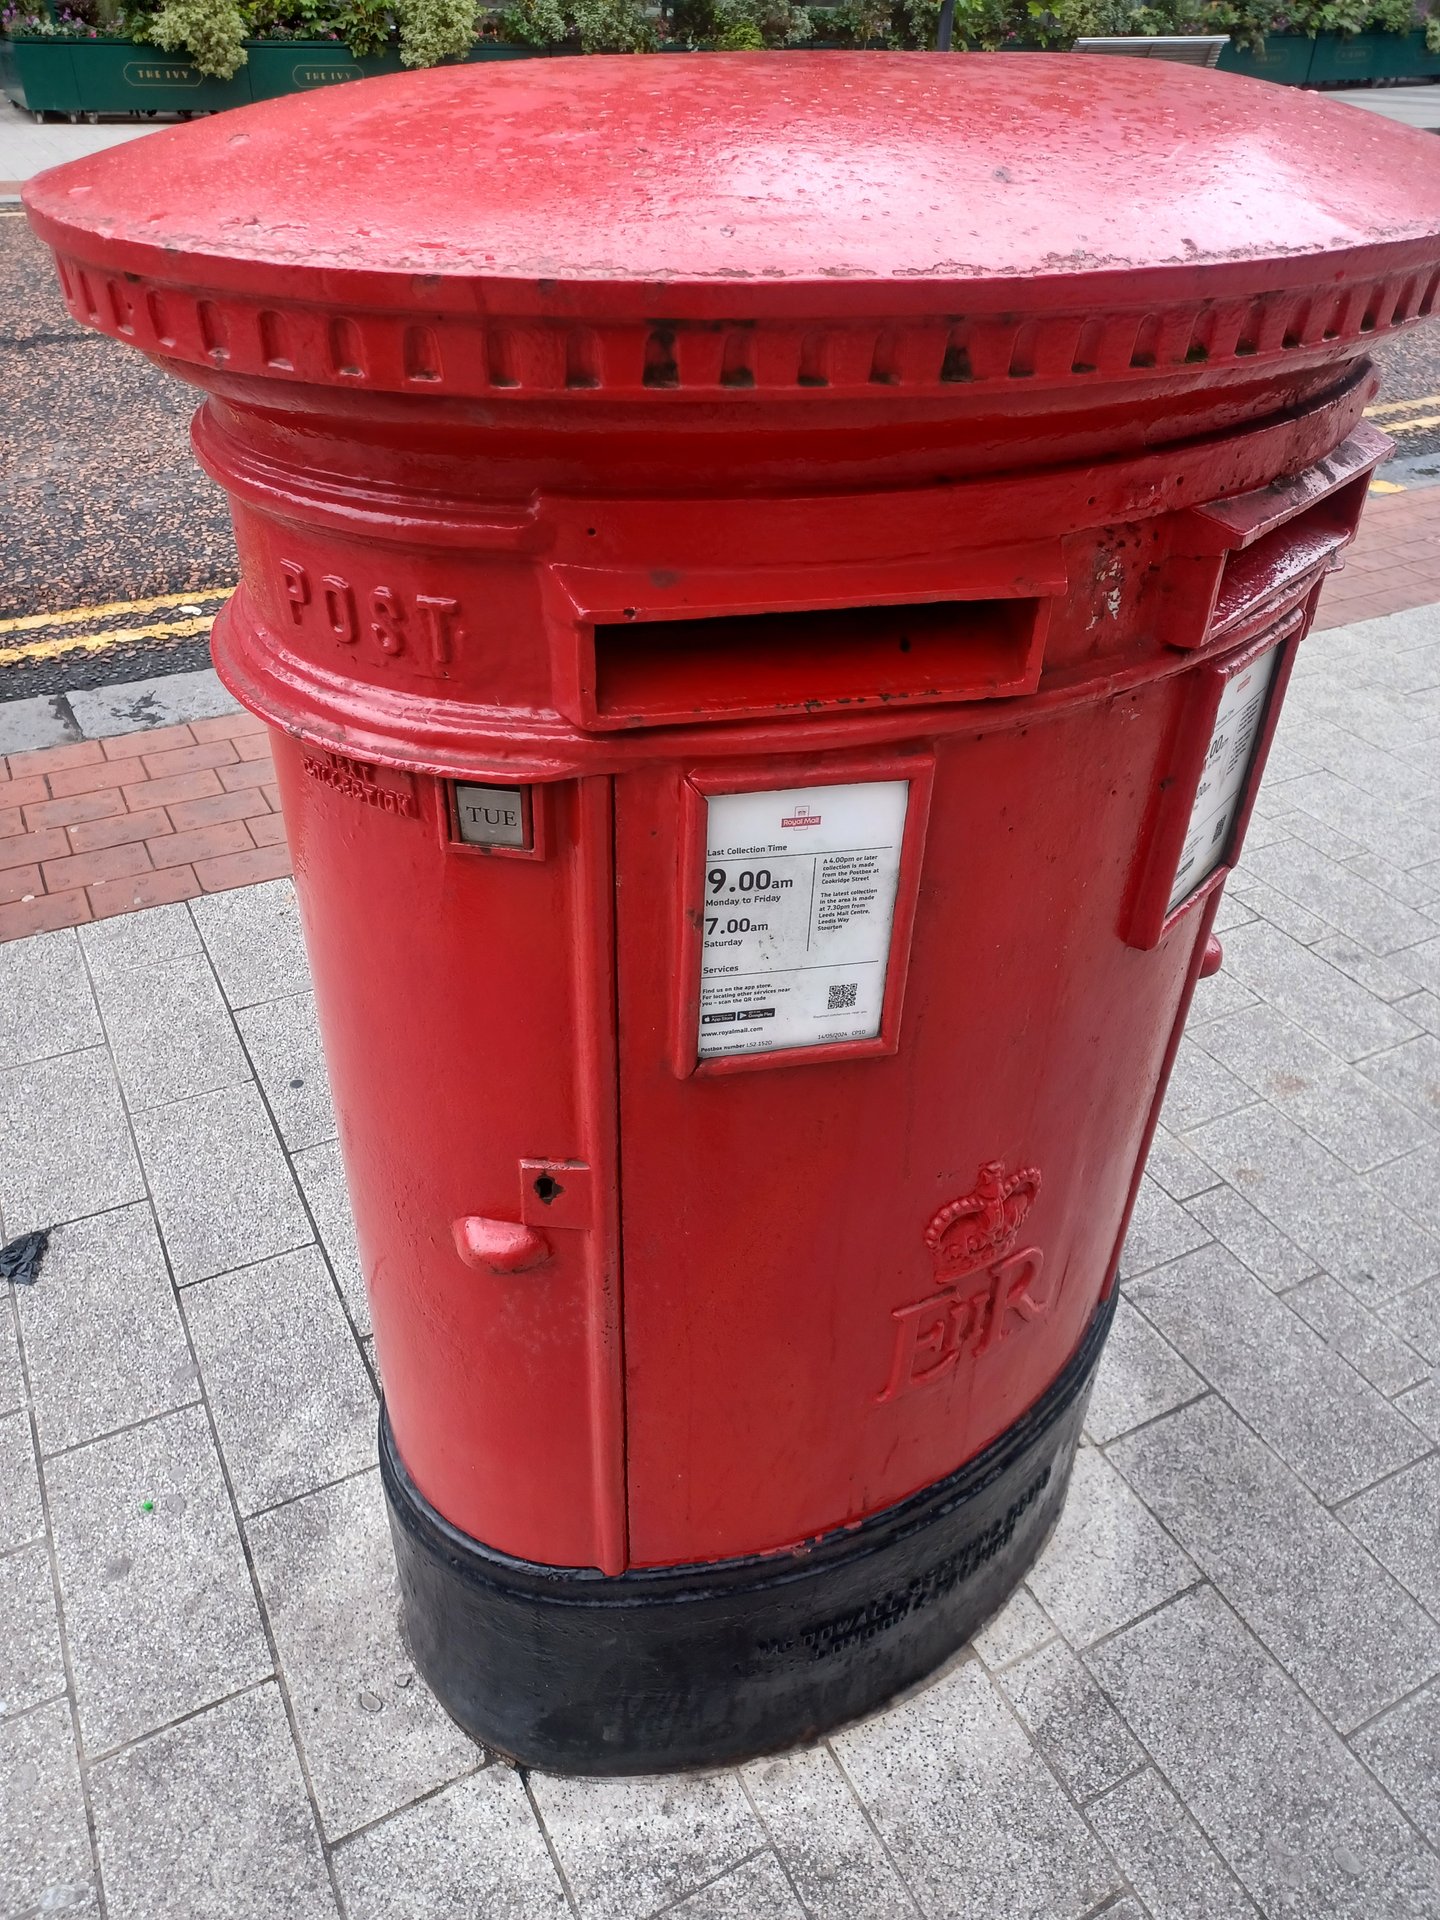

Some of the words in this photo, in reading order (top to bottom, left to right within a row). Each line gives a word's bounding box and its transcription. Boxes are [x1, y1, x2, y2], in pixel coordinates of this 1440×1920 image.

[138, 70, 161, 79] THE
[166, 70, 189, 79] IVY
[305, 72, 326, 80] THE
[331, 72, 351, 80] IVY
[280, 557, 458, 664] POST
[302, 756, 414, 820] COLLECTION
[466, 805, 517, 827] TUE
[783, 818, 803, 827] Royal
[804, 816, 821, 825] Mail
[727, 845, 766, 855] Collection
[768, 844, 788, 852] Time
[829, 856, 855, 864] 4.00pm
[823, 864, 851, 872] collection
[707, 868, 793, 894] 9.00am
[850, 888, 878, 896] collection
[705, 898, 739, 907] Monday
[742, 896, 751, 904] to
[754, 894, 781, 903] Friday
[827, 904, 850, 912] 7.30pm
[705, 917, 769, 936] 7.00am
[704, 939, 743, 948] Saturday
[703, 965, 739, 974] Services
[701, 1026, 764, 1037] www.royalmail.com
